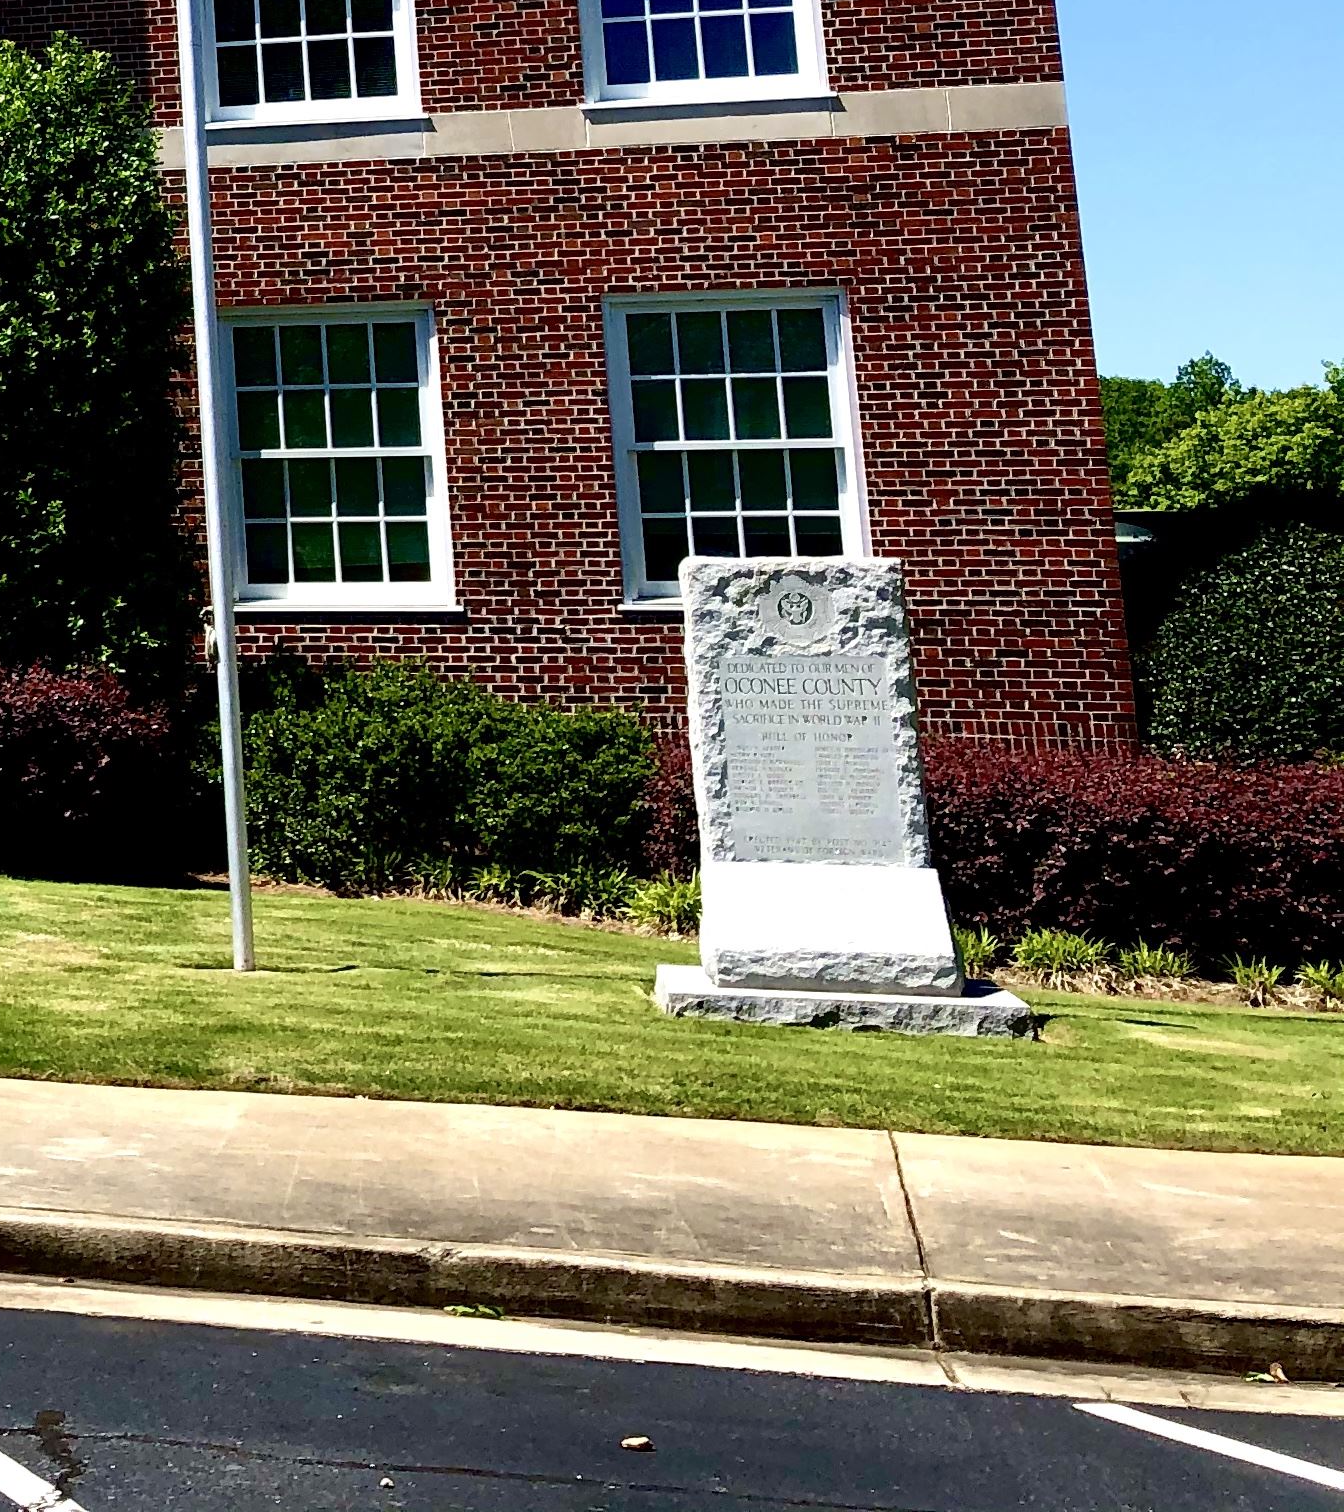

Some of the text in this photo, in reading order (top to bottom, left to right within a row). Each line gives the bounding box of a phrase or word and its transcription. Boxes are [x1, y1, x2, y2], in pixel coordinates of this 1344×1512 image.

[728, 663, 875, 673] DEDICATED TO OUR MEN OF
[724, 678, 882, 695] OCONEE COUNTY
[724, 699, 753, 709] WHO
[759, 699, 794, 710] MADE
[830, 700, 889, 711] SUPREME
[732, 714, 785, 724] SACRIFICE
[788, 714, 800, 724] IN
[802, 715, 842, 725] WORLD
[873, 715, 881, 726] II
[794, 732, 806, 742] OF
